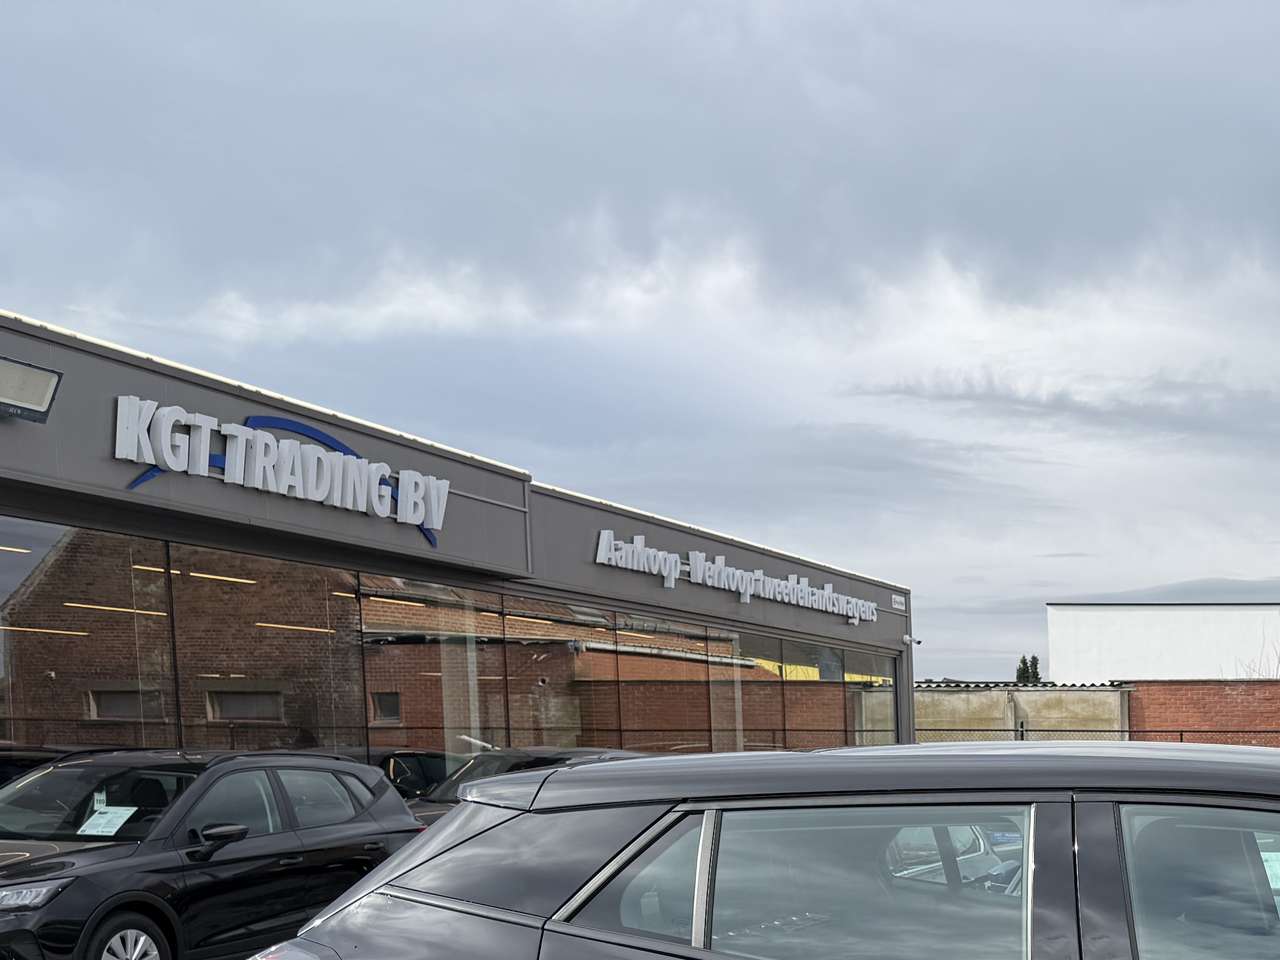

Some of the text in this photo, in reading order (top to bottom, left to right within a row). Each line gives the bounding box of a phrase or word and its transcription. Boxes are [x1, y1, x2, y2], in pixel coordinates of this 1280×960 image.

[115, 396, 449, 530] KGT TRADING BV
[596, 530, 680, 588] Aankoop
